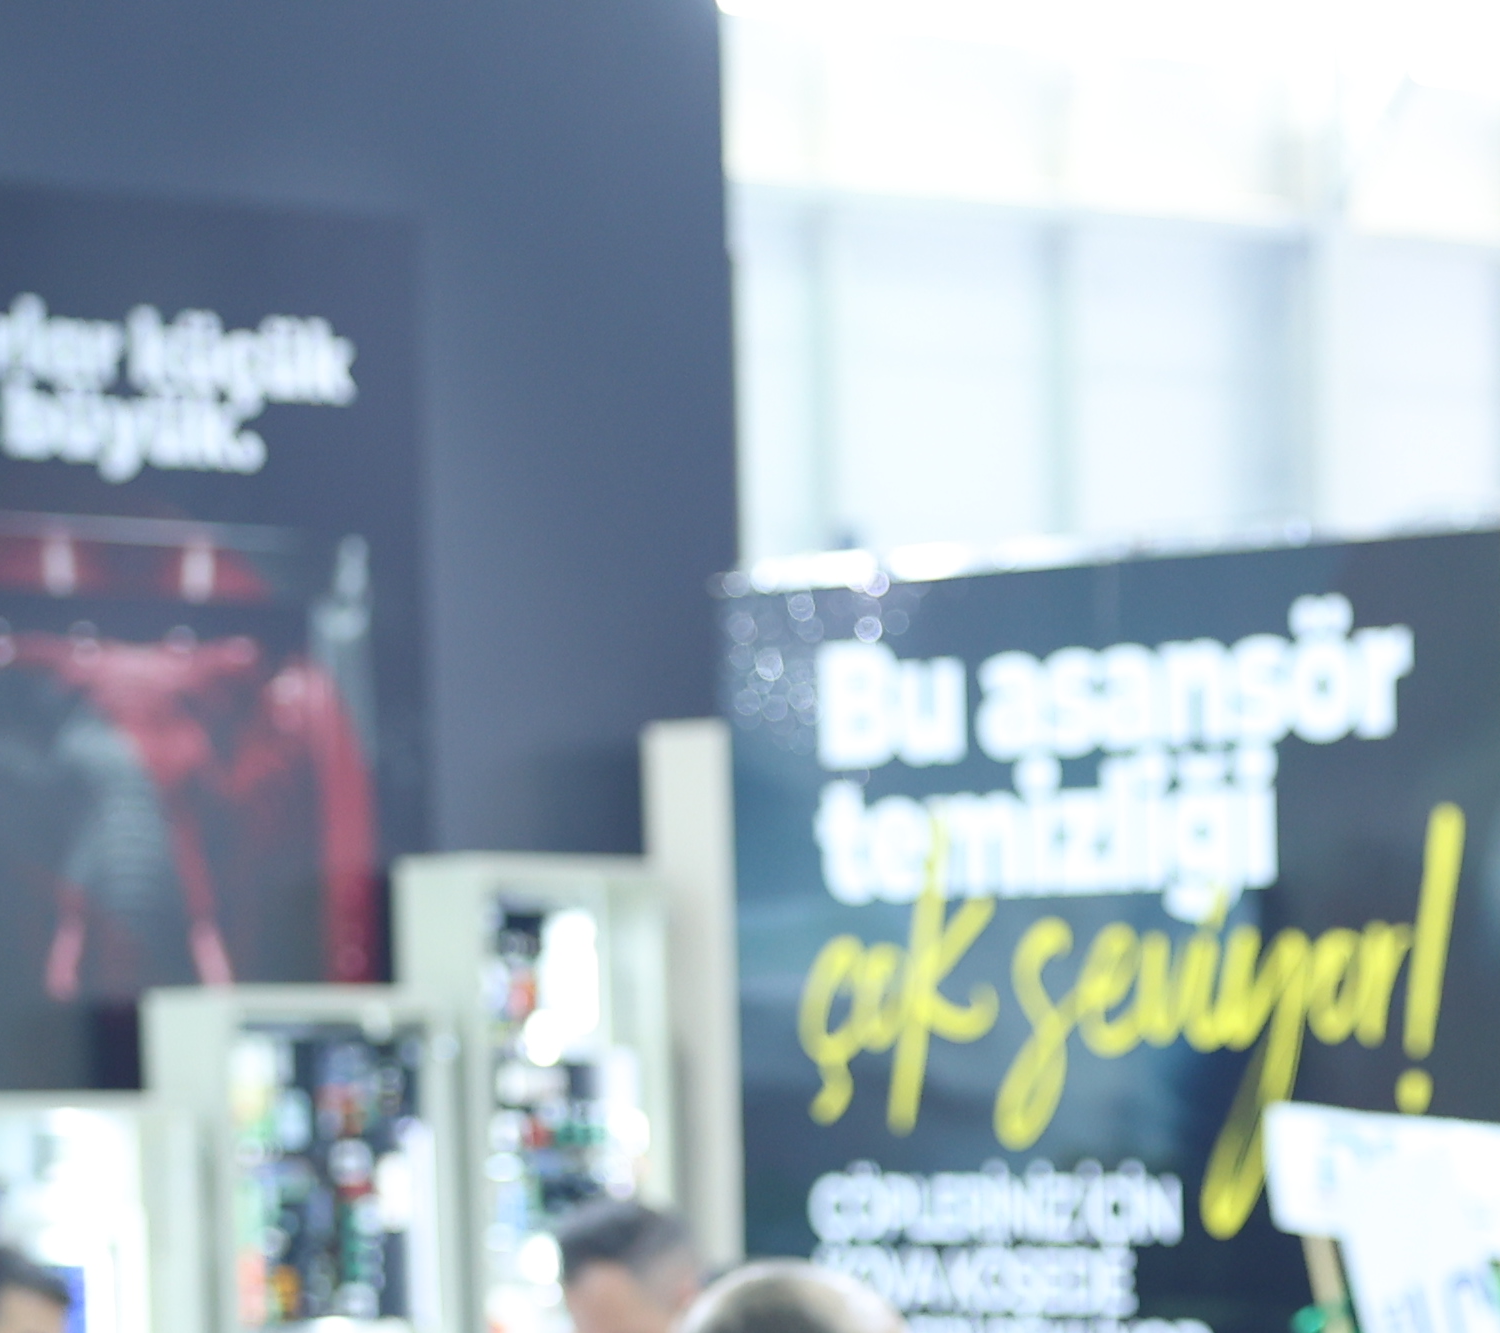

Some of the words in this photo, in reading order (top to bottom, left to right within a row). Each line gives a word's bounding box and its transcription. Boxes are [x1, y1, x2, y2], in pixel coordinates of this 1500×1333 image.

[815, 638, 968, 770] Bu
[976, 595, 1414, 763] asansör
[814, 743, 1279, 922] temizliği
